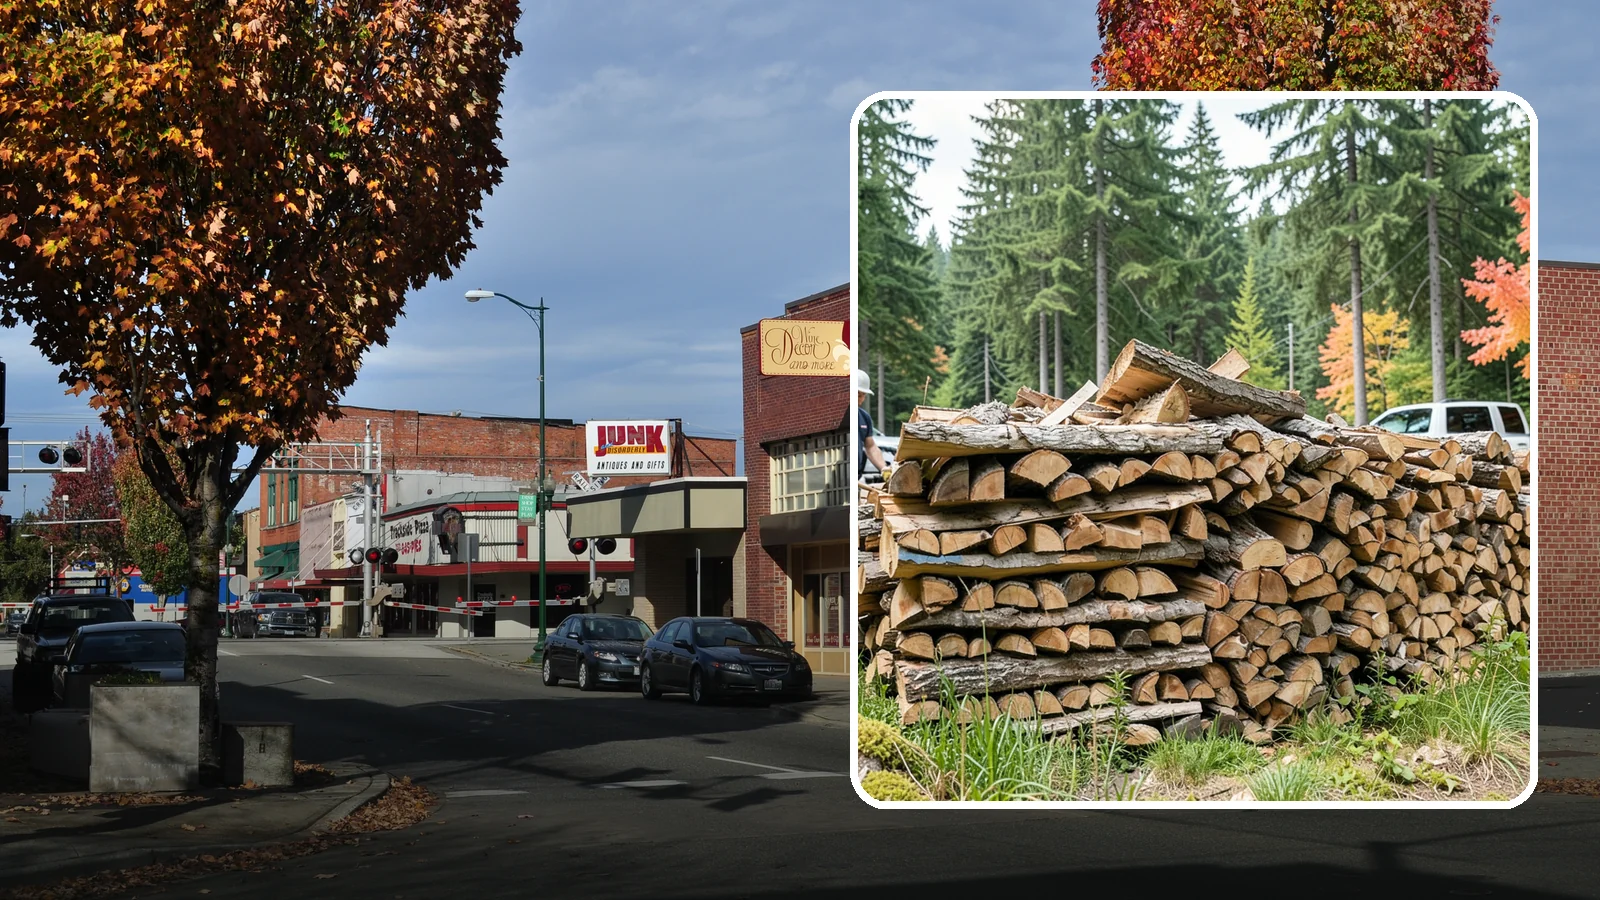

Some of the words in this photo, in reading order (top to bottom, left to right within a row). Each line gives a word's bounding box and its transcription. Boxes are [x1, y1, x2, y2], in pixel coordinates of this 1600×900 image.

[595, 425, 665, 457] JUNK
[597, 461, 628, 470] ANTIQUES
[631, 461, 644, 470] AND
[647, 461, 665, 469] GIFTS
[415, 519, 429, 534] Pizza
